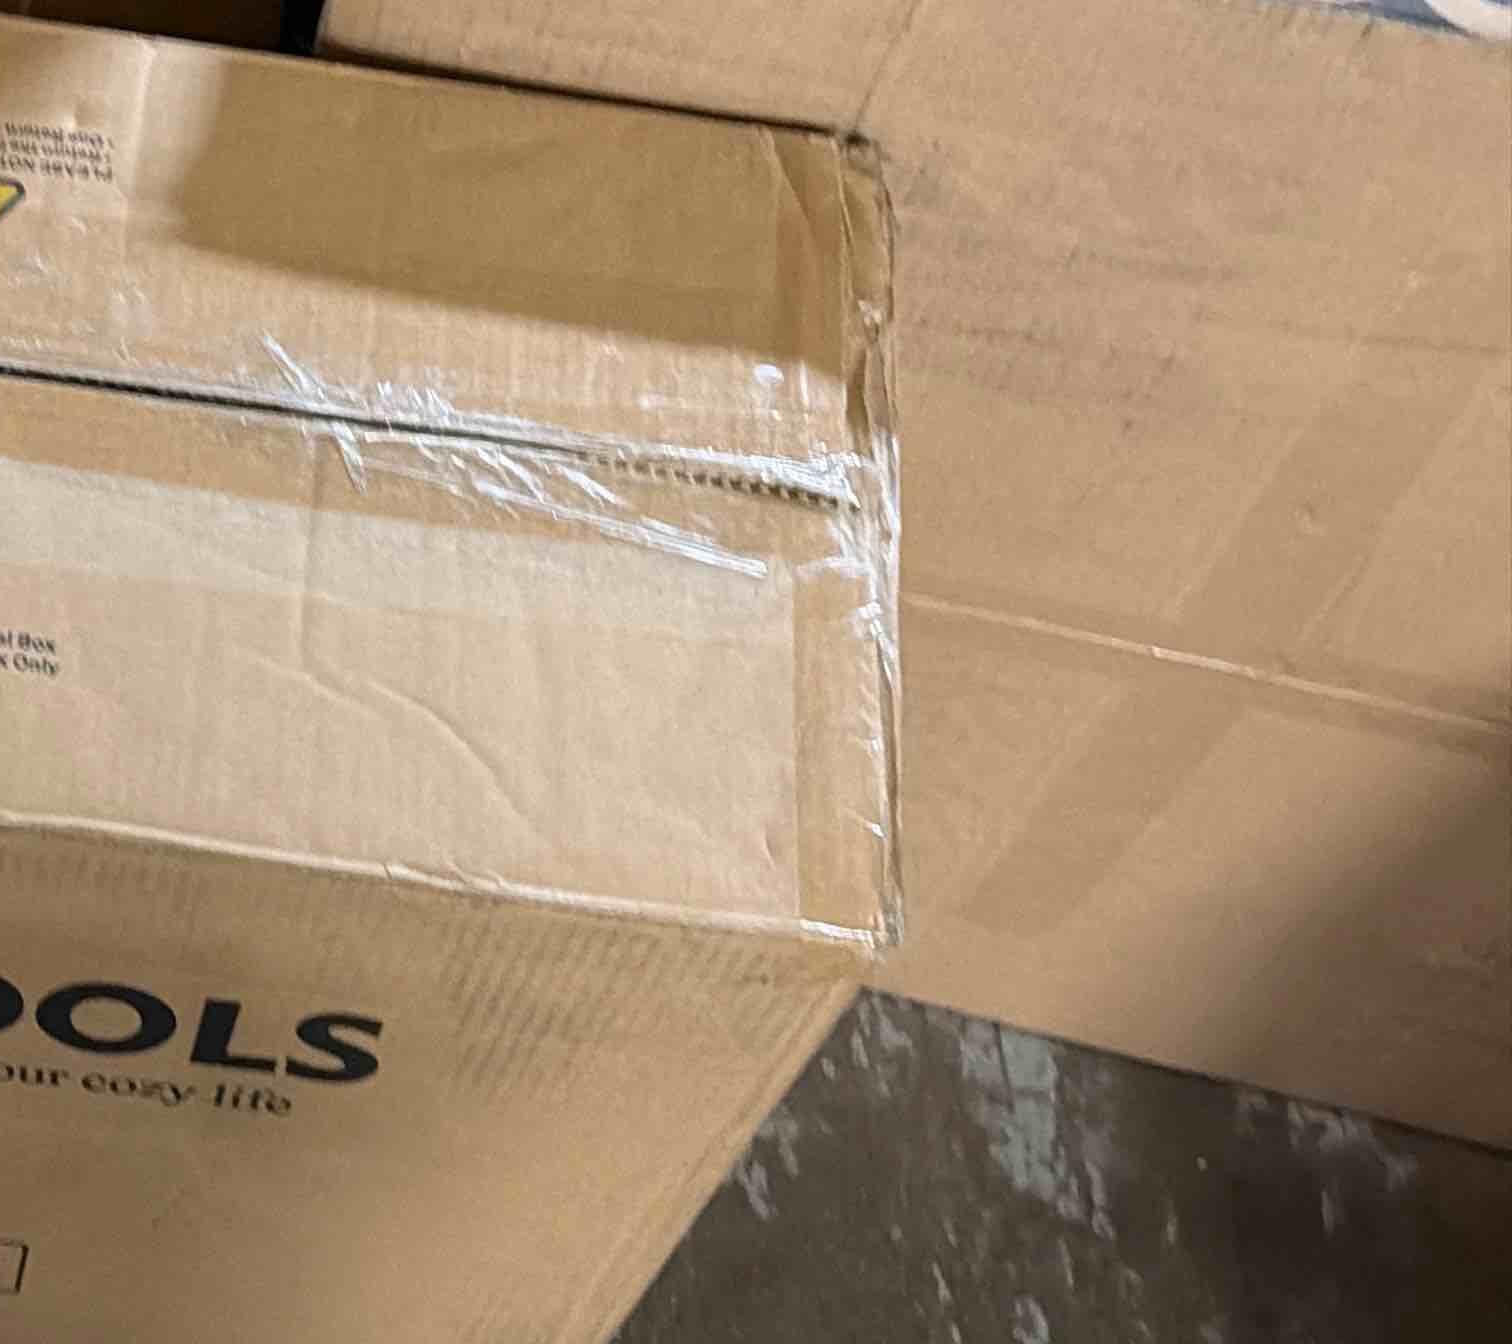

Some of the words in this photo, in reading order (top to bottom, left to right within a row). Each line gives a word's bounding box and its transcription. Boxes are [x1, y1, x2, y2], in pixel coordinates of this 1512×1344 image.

[17, 631, 56, 656] Box
[13, 653, 59, 678] Only
[81, 1072, 196, 1109] cozy
[212, 1083, 294, 1117] life
